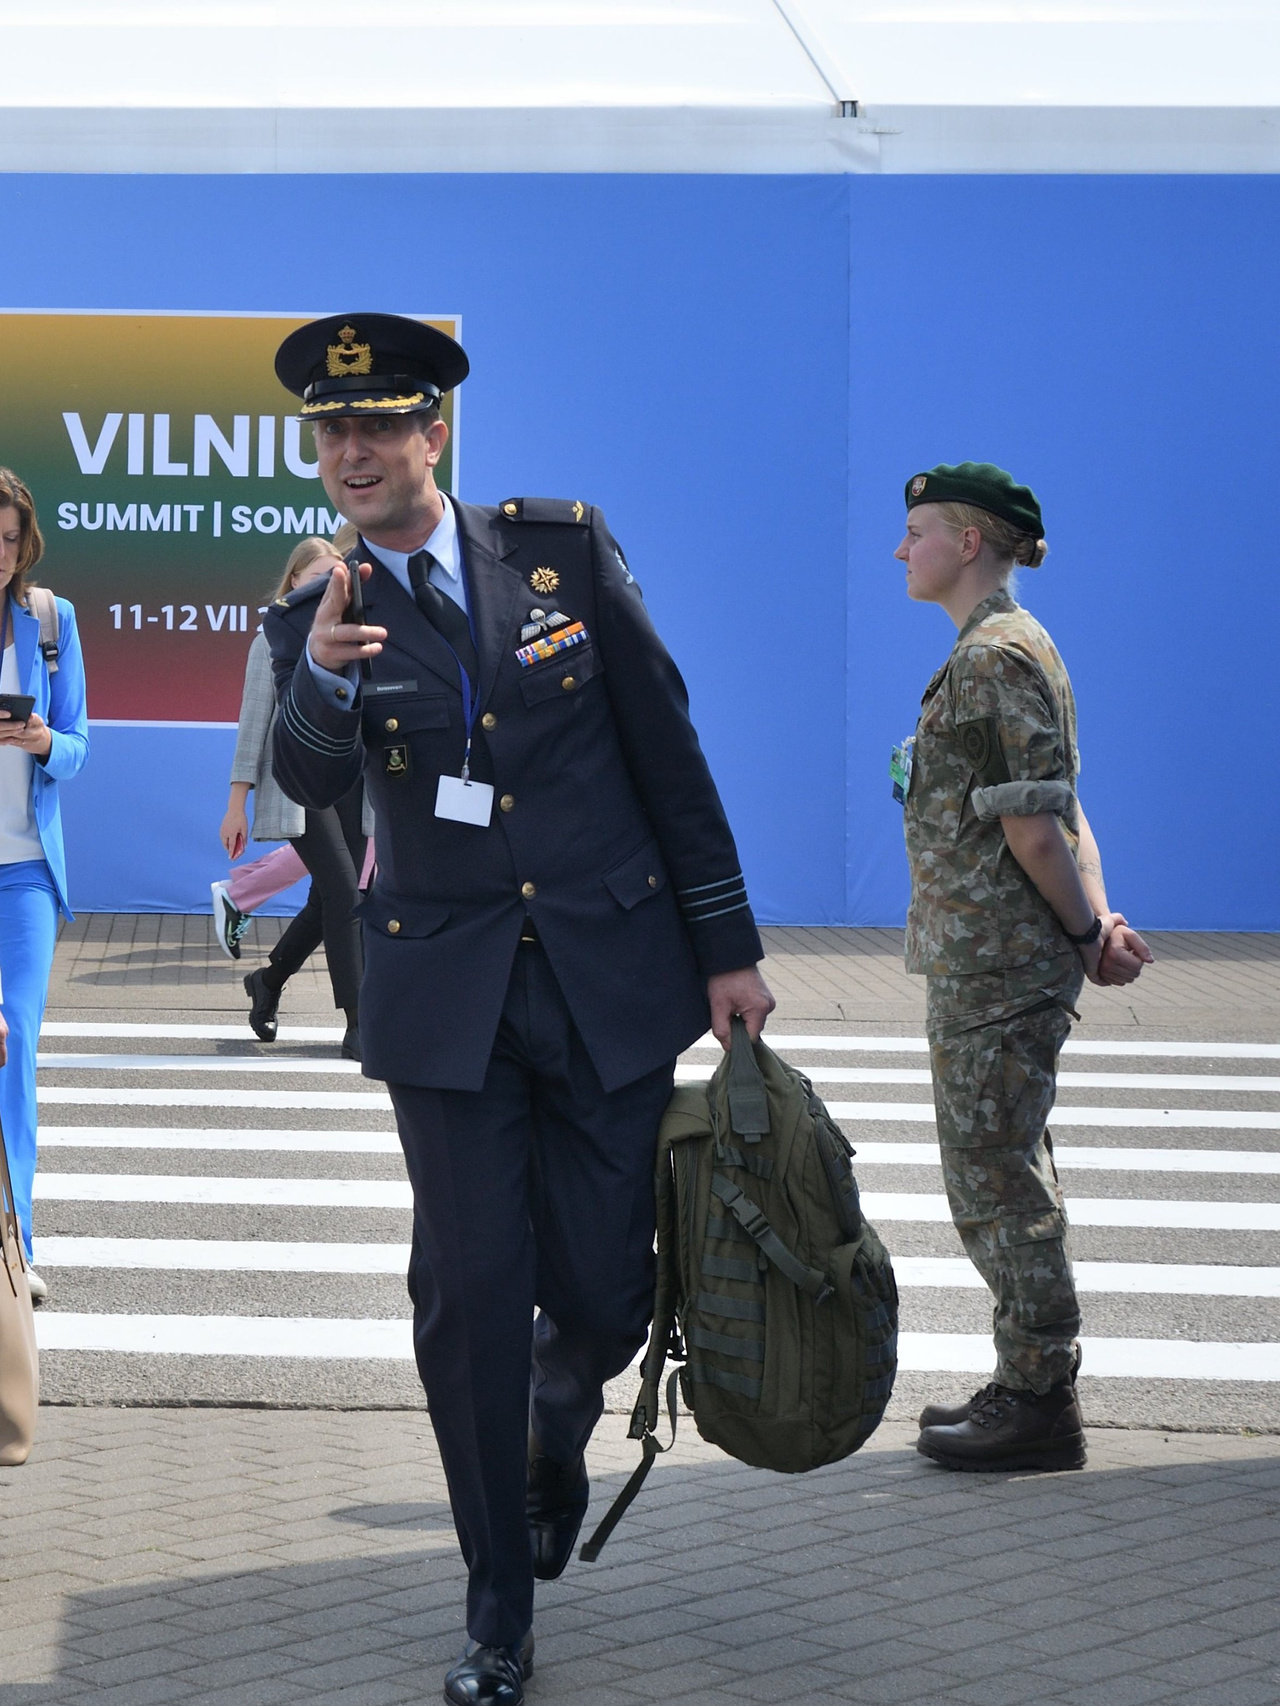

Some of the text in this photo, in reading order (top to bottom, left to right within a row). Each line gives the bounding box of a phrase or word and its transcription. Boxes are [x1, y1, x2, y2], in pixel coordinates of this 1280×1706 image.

[62, 412, 322, 479] VILNIU
[57, 501, 205, 533] SUMMIT
[231, 505, 348, 535] SOMM
[109, 603, 198, 631] 11-12
[205, 605, 247, 632] VII
